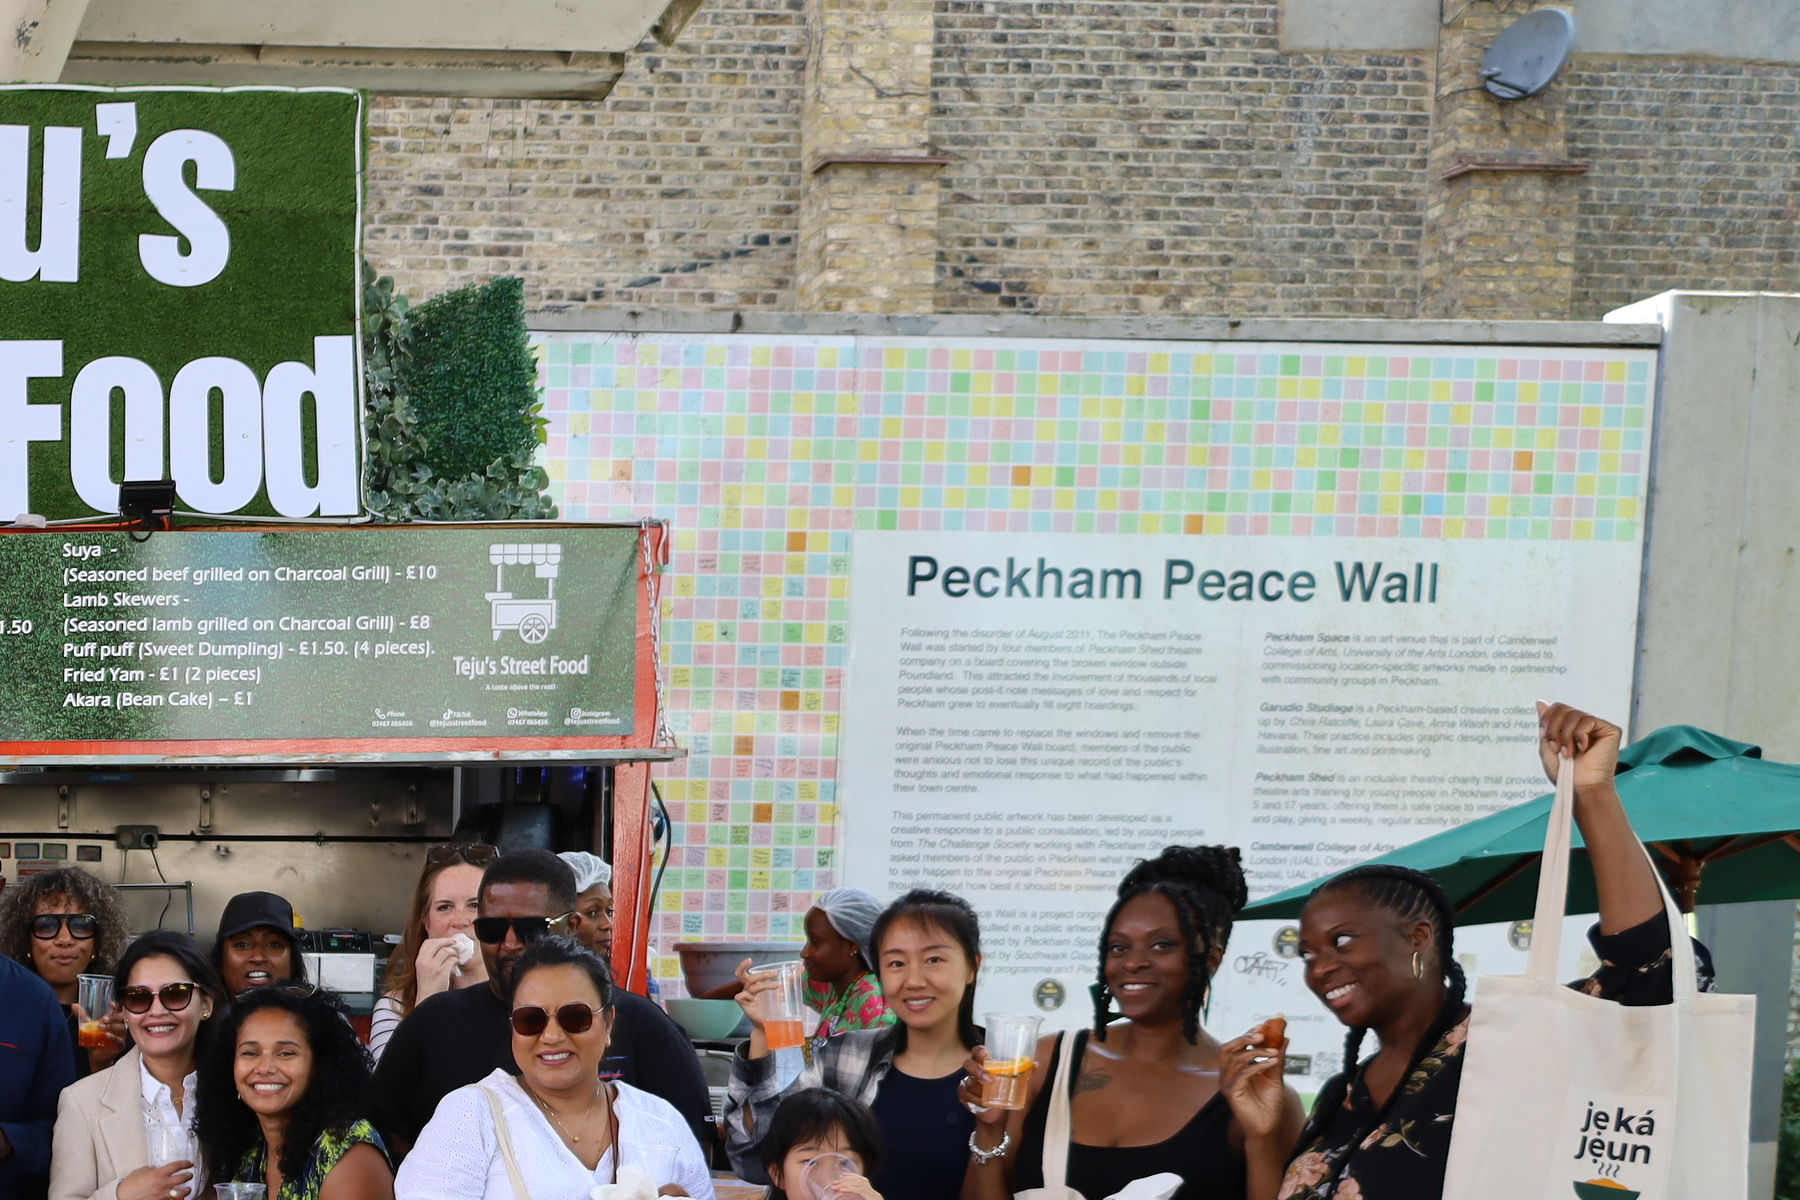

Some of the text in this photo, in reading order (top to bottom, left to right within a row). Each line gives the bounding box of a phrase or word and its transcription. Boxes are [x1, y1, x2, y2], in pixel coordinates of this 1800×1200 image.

[62, 542, 101, 561] Suya
[63, 564, 437, 586] (Seasoned beef grilled on Charcoal Grill) £10
[906, 555, 1438, 603] Peckham Peace Wall
[63, 591, 180, 607] Lamb Skewers
[63, 614, 430, 636] (Seasoned lamb grilled on Charcoal Grill) £8
[63, 639, 435, 660] Puff puff (Sweet Dumpling) £1.50. (4 pieces).
[63, 665, 261, 685] Fried Yam £1 (2 pieces)
[452, 654, 588, 680] Teju's Street Food
[1262, 661, 1337, 673] commissioning
[1421, 662, 1465, 673] artworks
[1466, 662, 1496, 673] made
[1498, 664, 1508, 672] in
[1509, 663, 1567, 675] partnership
[62, 690, 252, 710] Akara (Bean Cake) £1
